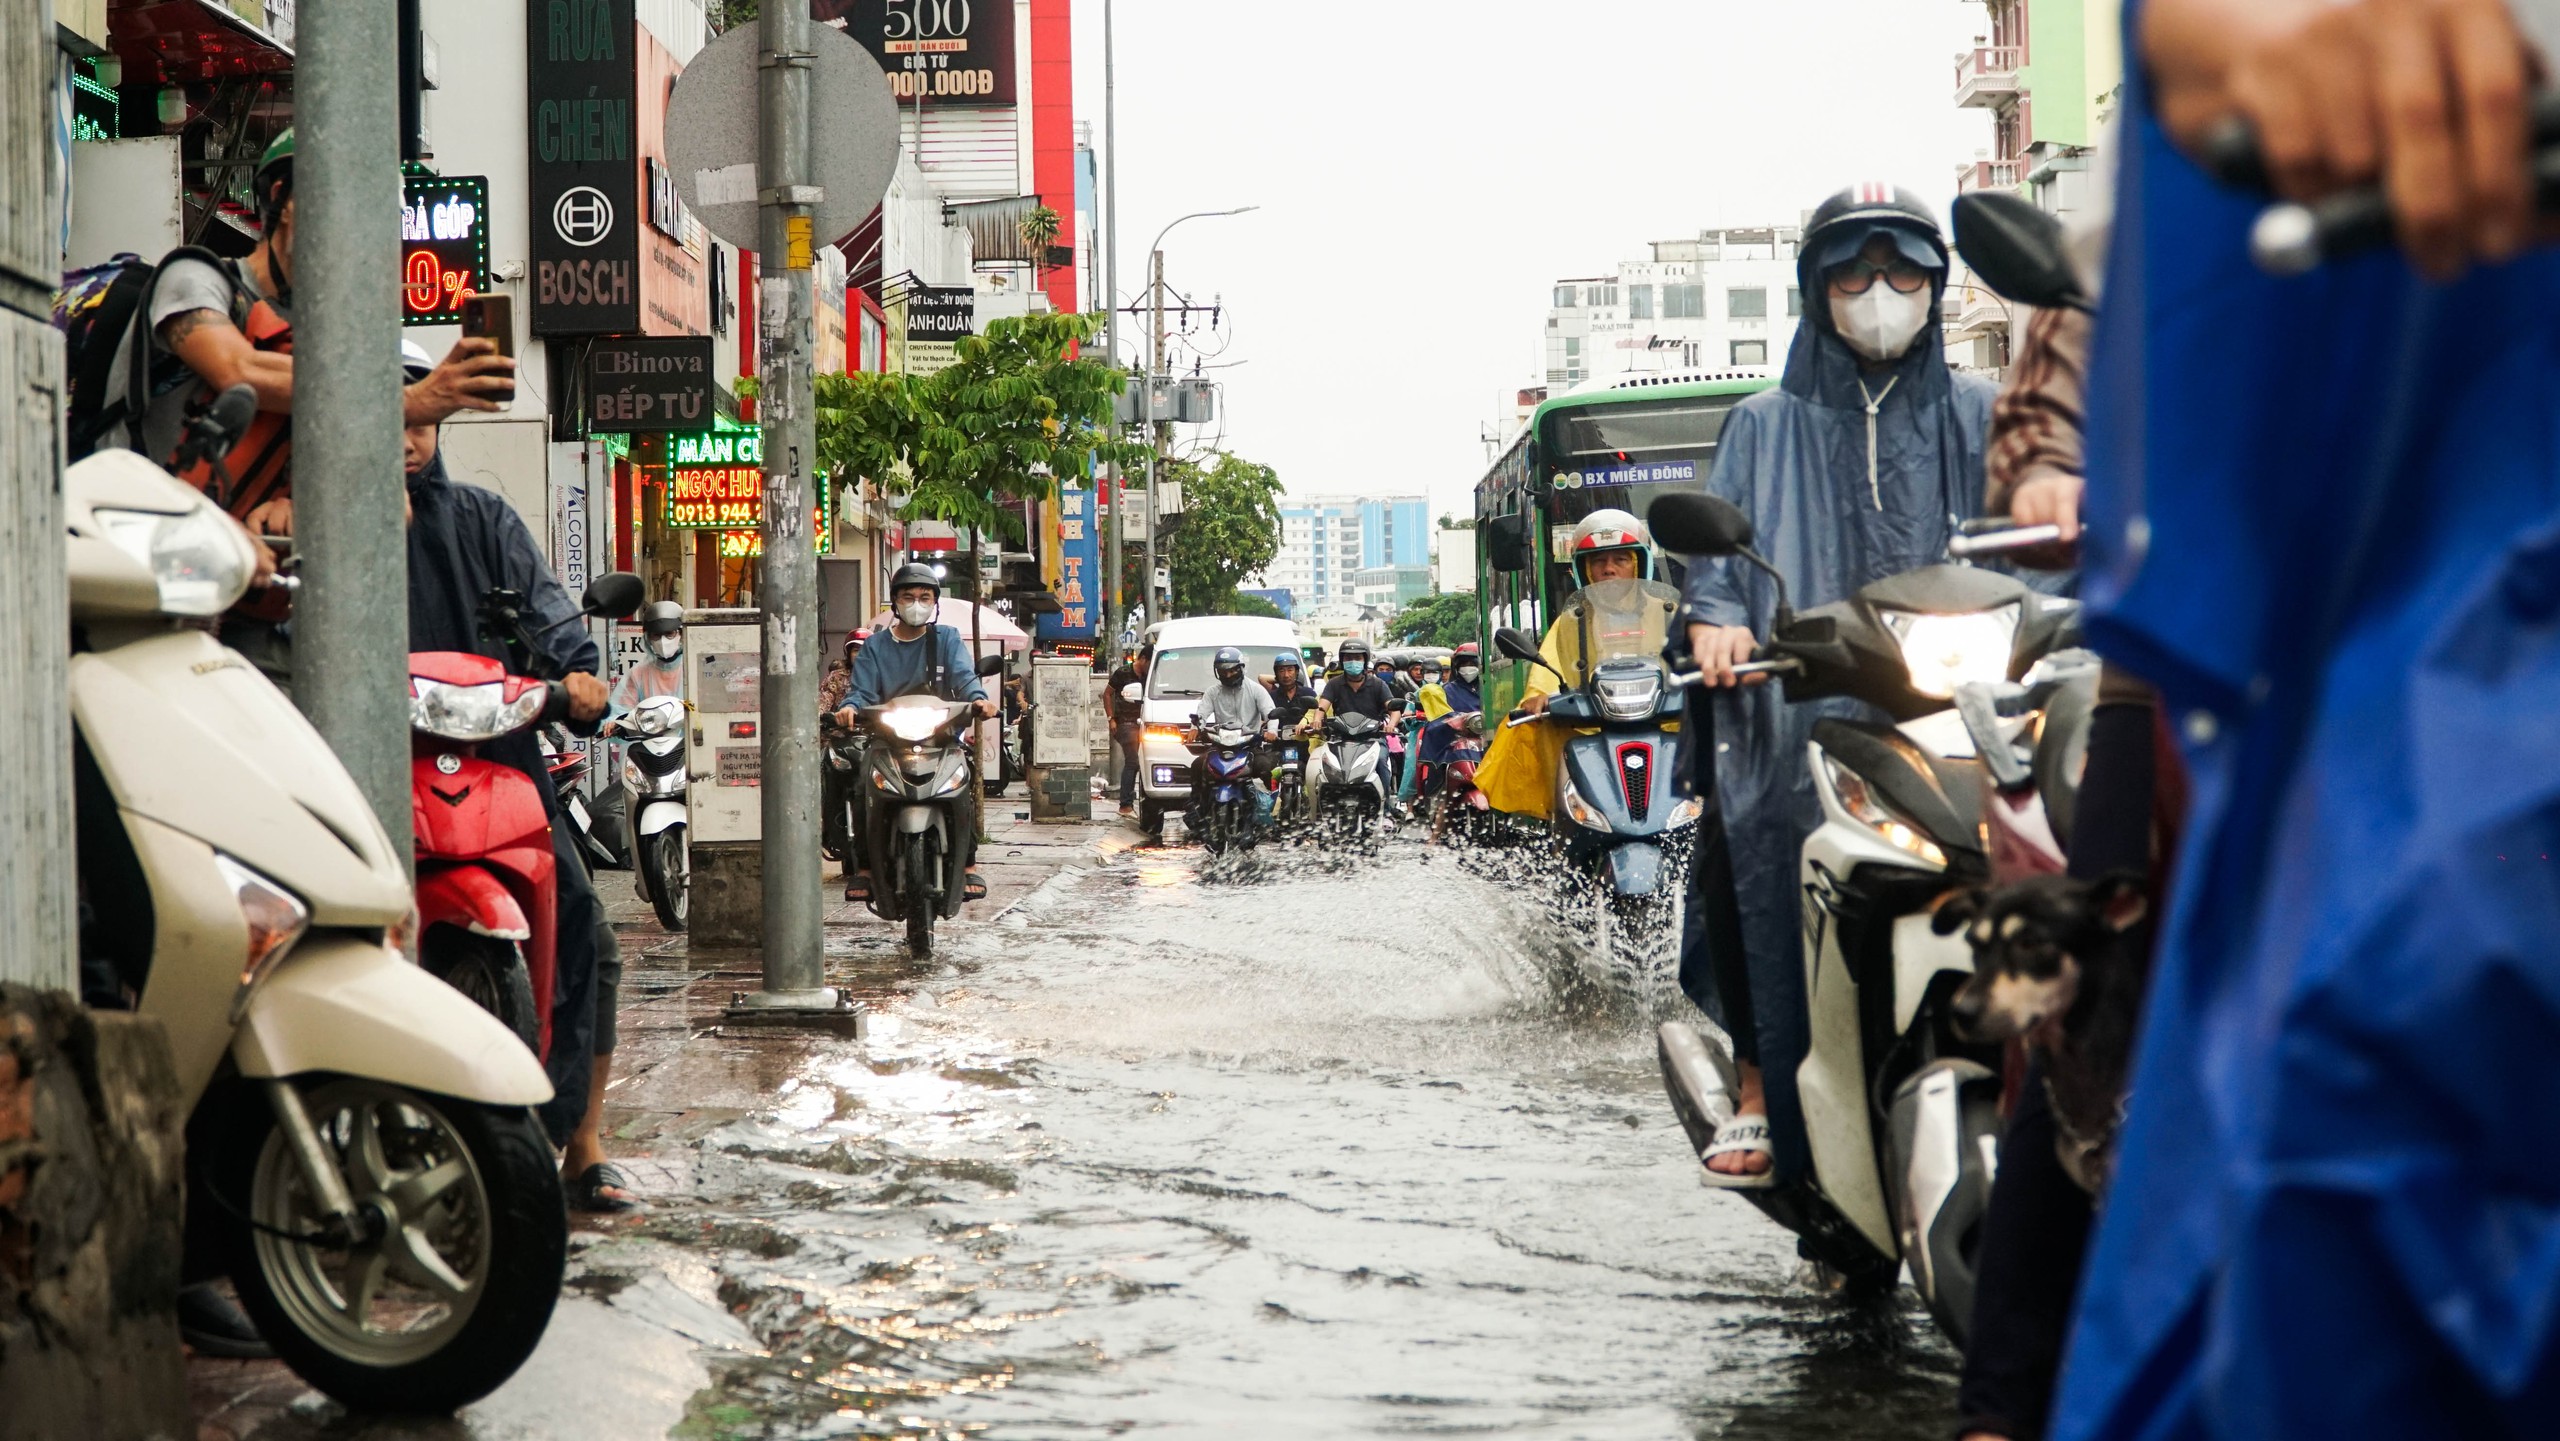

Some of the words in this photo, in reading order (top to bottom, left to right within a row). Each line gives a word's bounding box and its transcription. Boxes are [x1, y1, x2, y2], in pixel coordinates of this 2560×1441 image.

[884, 0, 971, 38] 500
[930, 53, 949, 68] TỪ
[538, 86, 626, 162] CHÉN
[402, 196, 430, 241] RẢ
[432, 195, 475, 241] GÓP
[407, 250, 477, 311] 0%
[539, 259, 630, 305] BOSCH
[908, 314, 935, 331] ANH
[936, 311, 973, 331] QUÂN
[613, 351, 703, 374] Binova
[596, 385, 653, 421] BẾP
[659, 386, 705, 419] TỪ
[677, 432, 733, 463] MÀN
[675, 469, 725, 503] NGỌC
[1585, 471, 1606, 485] BX
[1610, 466, 1649, 483] MIỀN
[1652, 465, 1693, 480] ĐÔNG
[675, 504, 716, 522] 0913
[720, 503, 751, 521] 944
[568, 485, 586, 591] ALCOREST
[556, 569, 564, 583] pan
